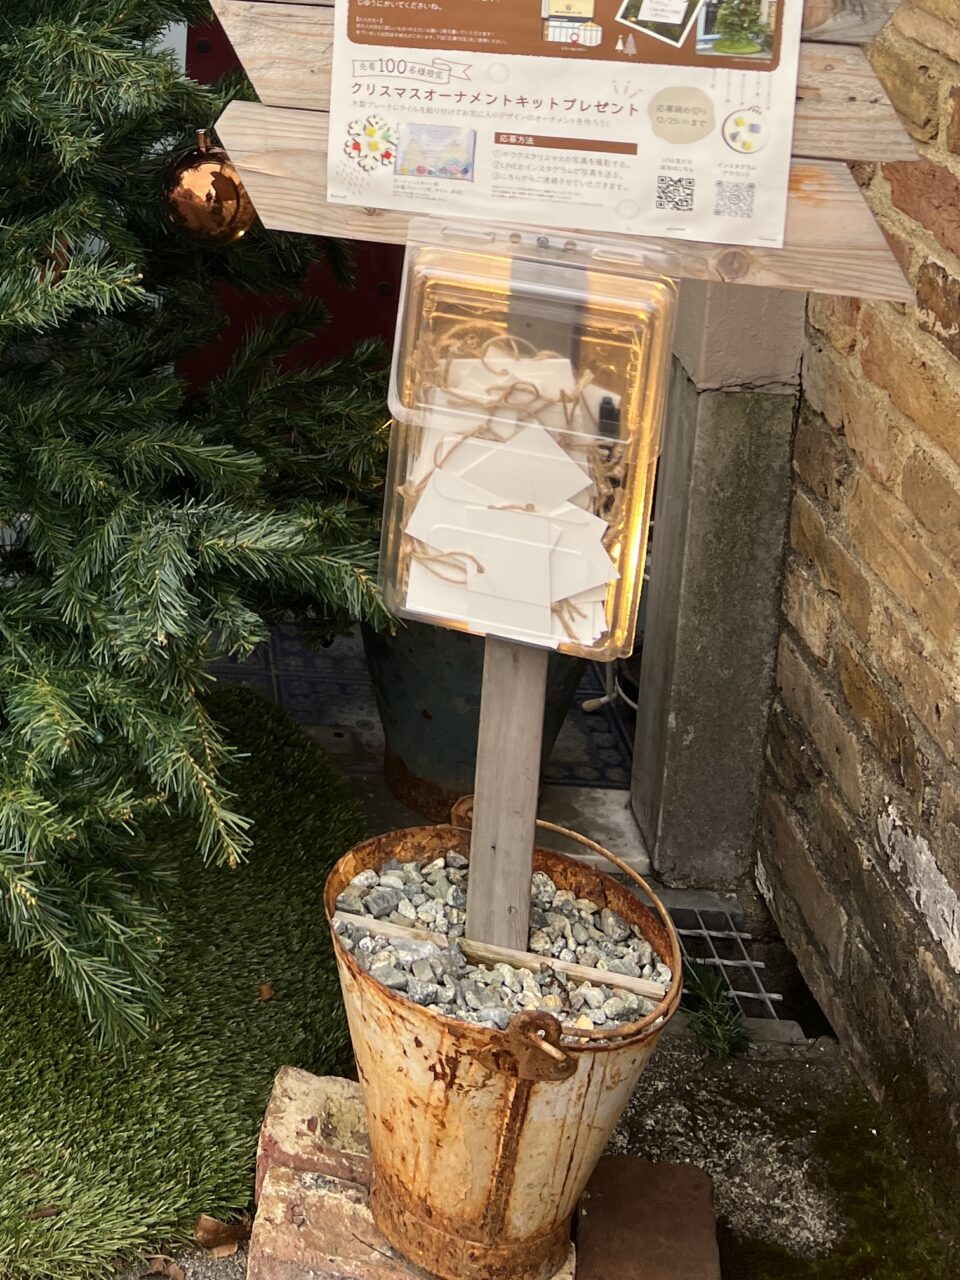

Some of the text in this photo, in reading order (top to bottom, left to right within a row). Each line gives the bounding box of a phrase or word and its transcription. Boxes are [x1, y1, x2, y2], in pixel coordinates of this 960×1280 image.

[351, 82, 639, 117] クリスマスオーナメントキットプレゼント
[499, 134, 535, 145] 応募方法
